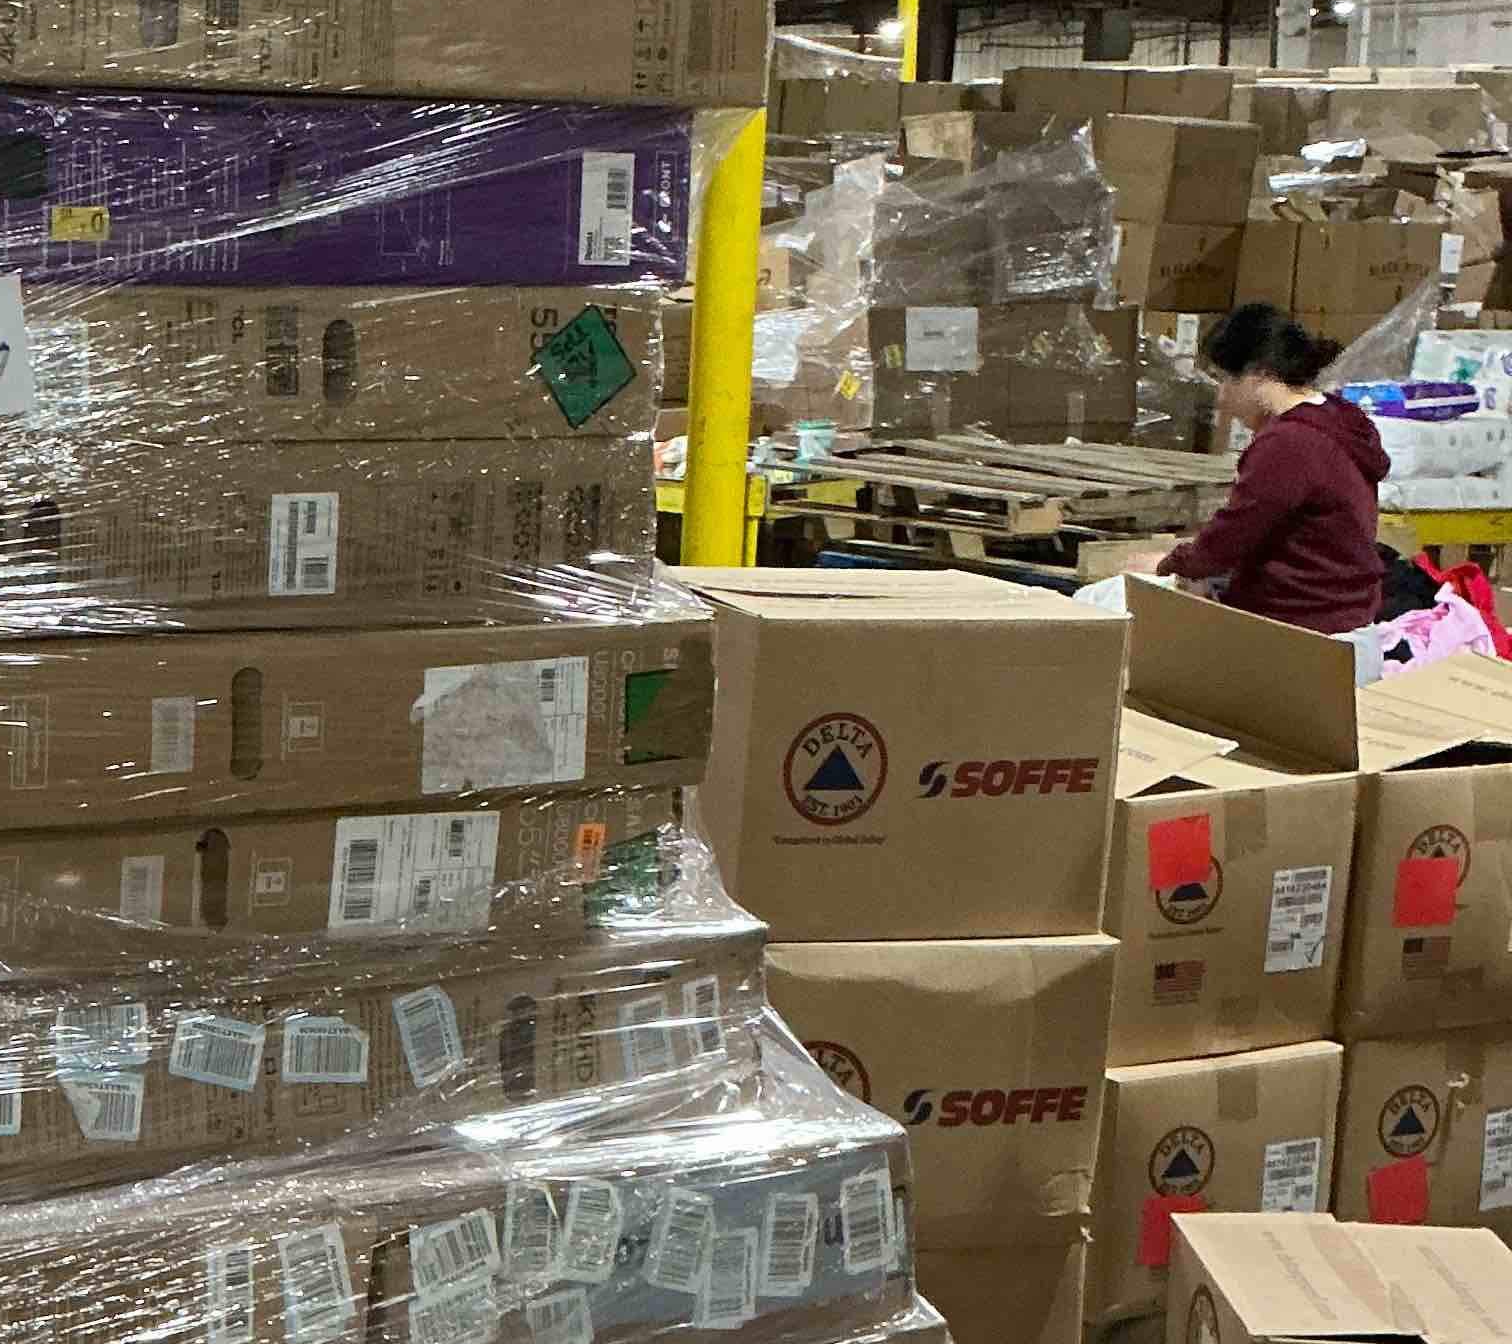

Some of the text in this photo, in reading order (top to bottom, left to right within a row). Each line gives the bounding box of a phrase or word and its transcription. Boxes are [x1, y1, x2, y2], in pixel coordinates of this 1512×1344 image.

[803, 722, 876, 760] DELTA
[949, 757, 1100, 799] SOFFE
[937, 1085, 1089, 1129] SOFFE
